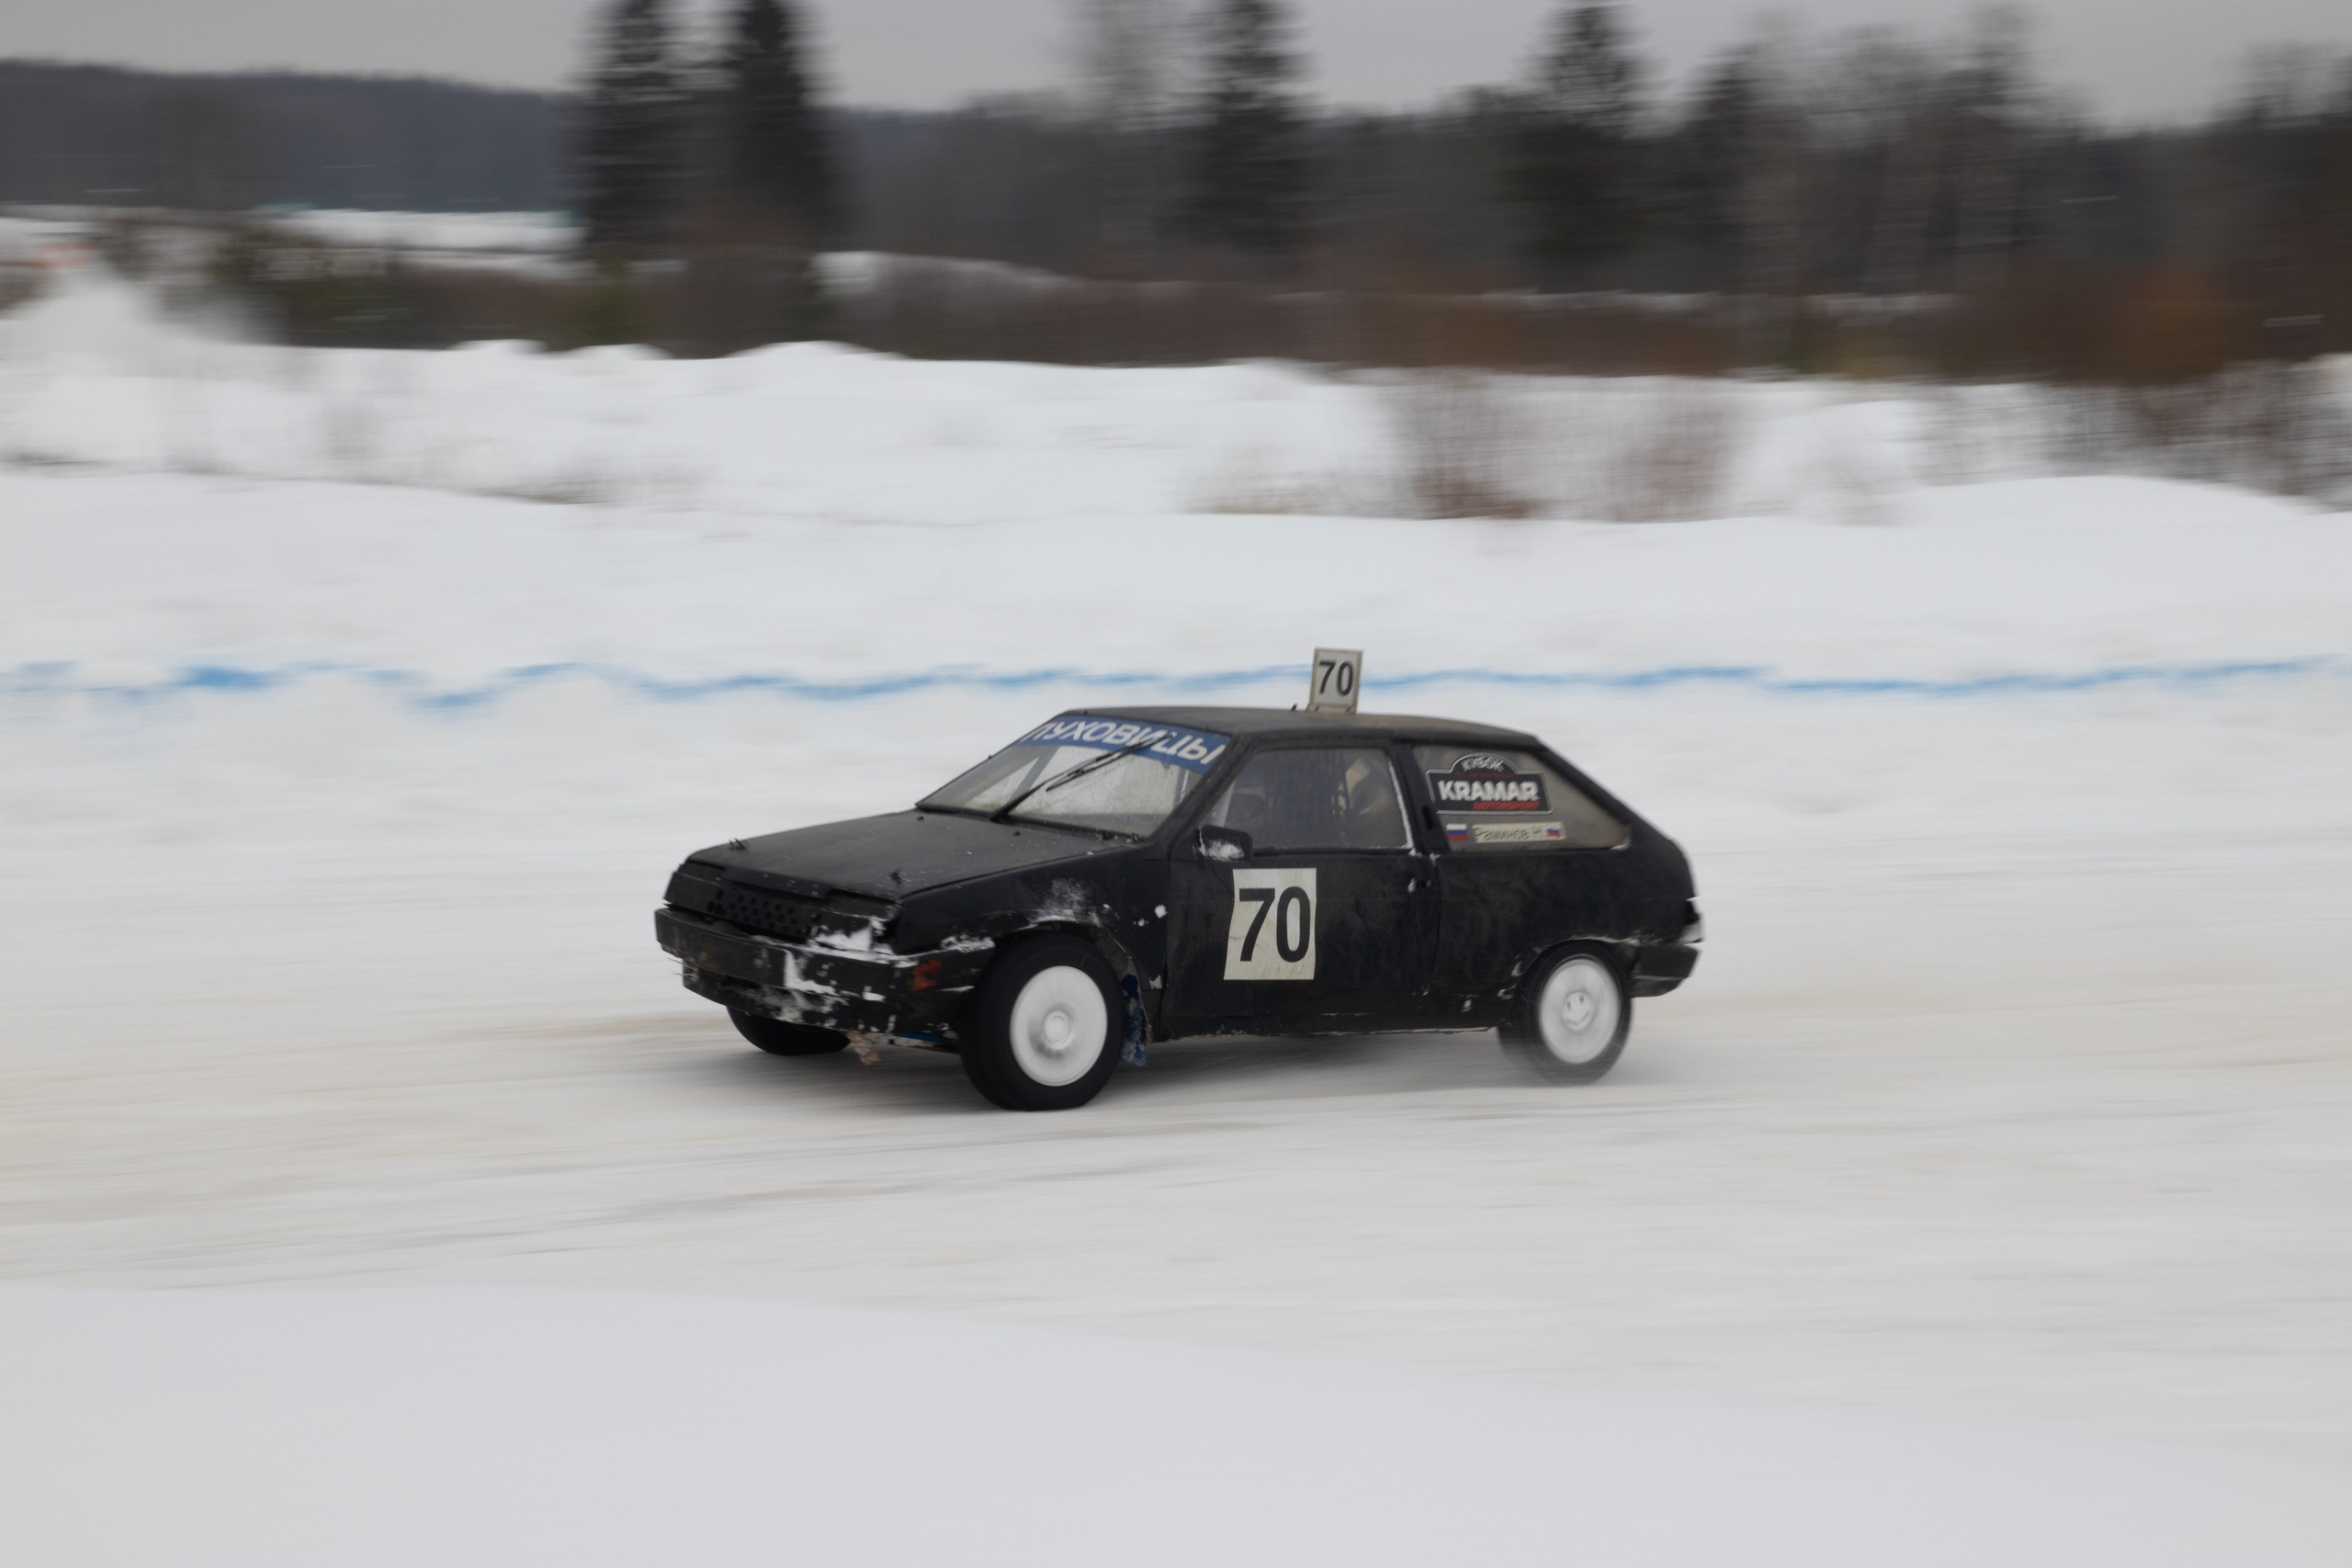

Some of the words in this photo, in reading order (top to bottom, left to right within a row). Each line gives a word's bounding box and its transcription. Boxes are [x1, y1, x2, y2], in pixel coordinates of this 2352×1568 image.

[1318, 660, 1353, 696] 70
[1020, 720, 1227, 765] ЛУХОВИЦЫ
[1438, 780, 1541, 801] KRAMAR
[1238, 886, 1311, 963] 70
